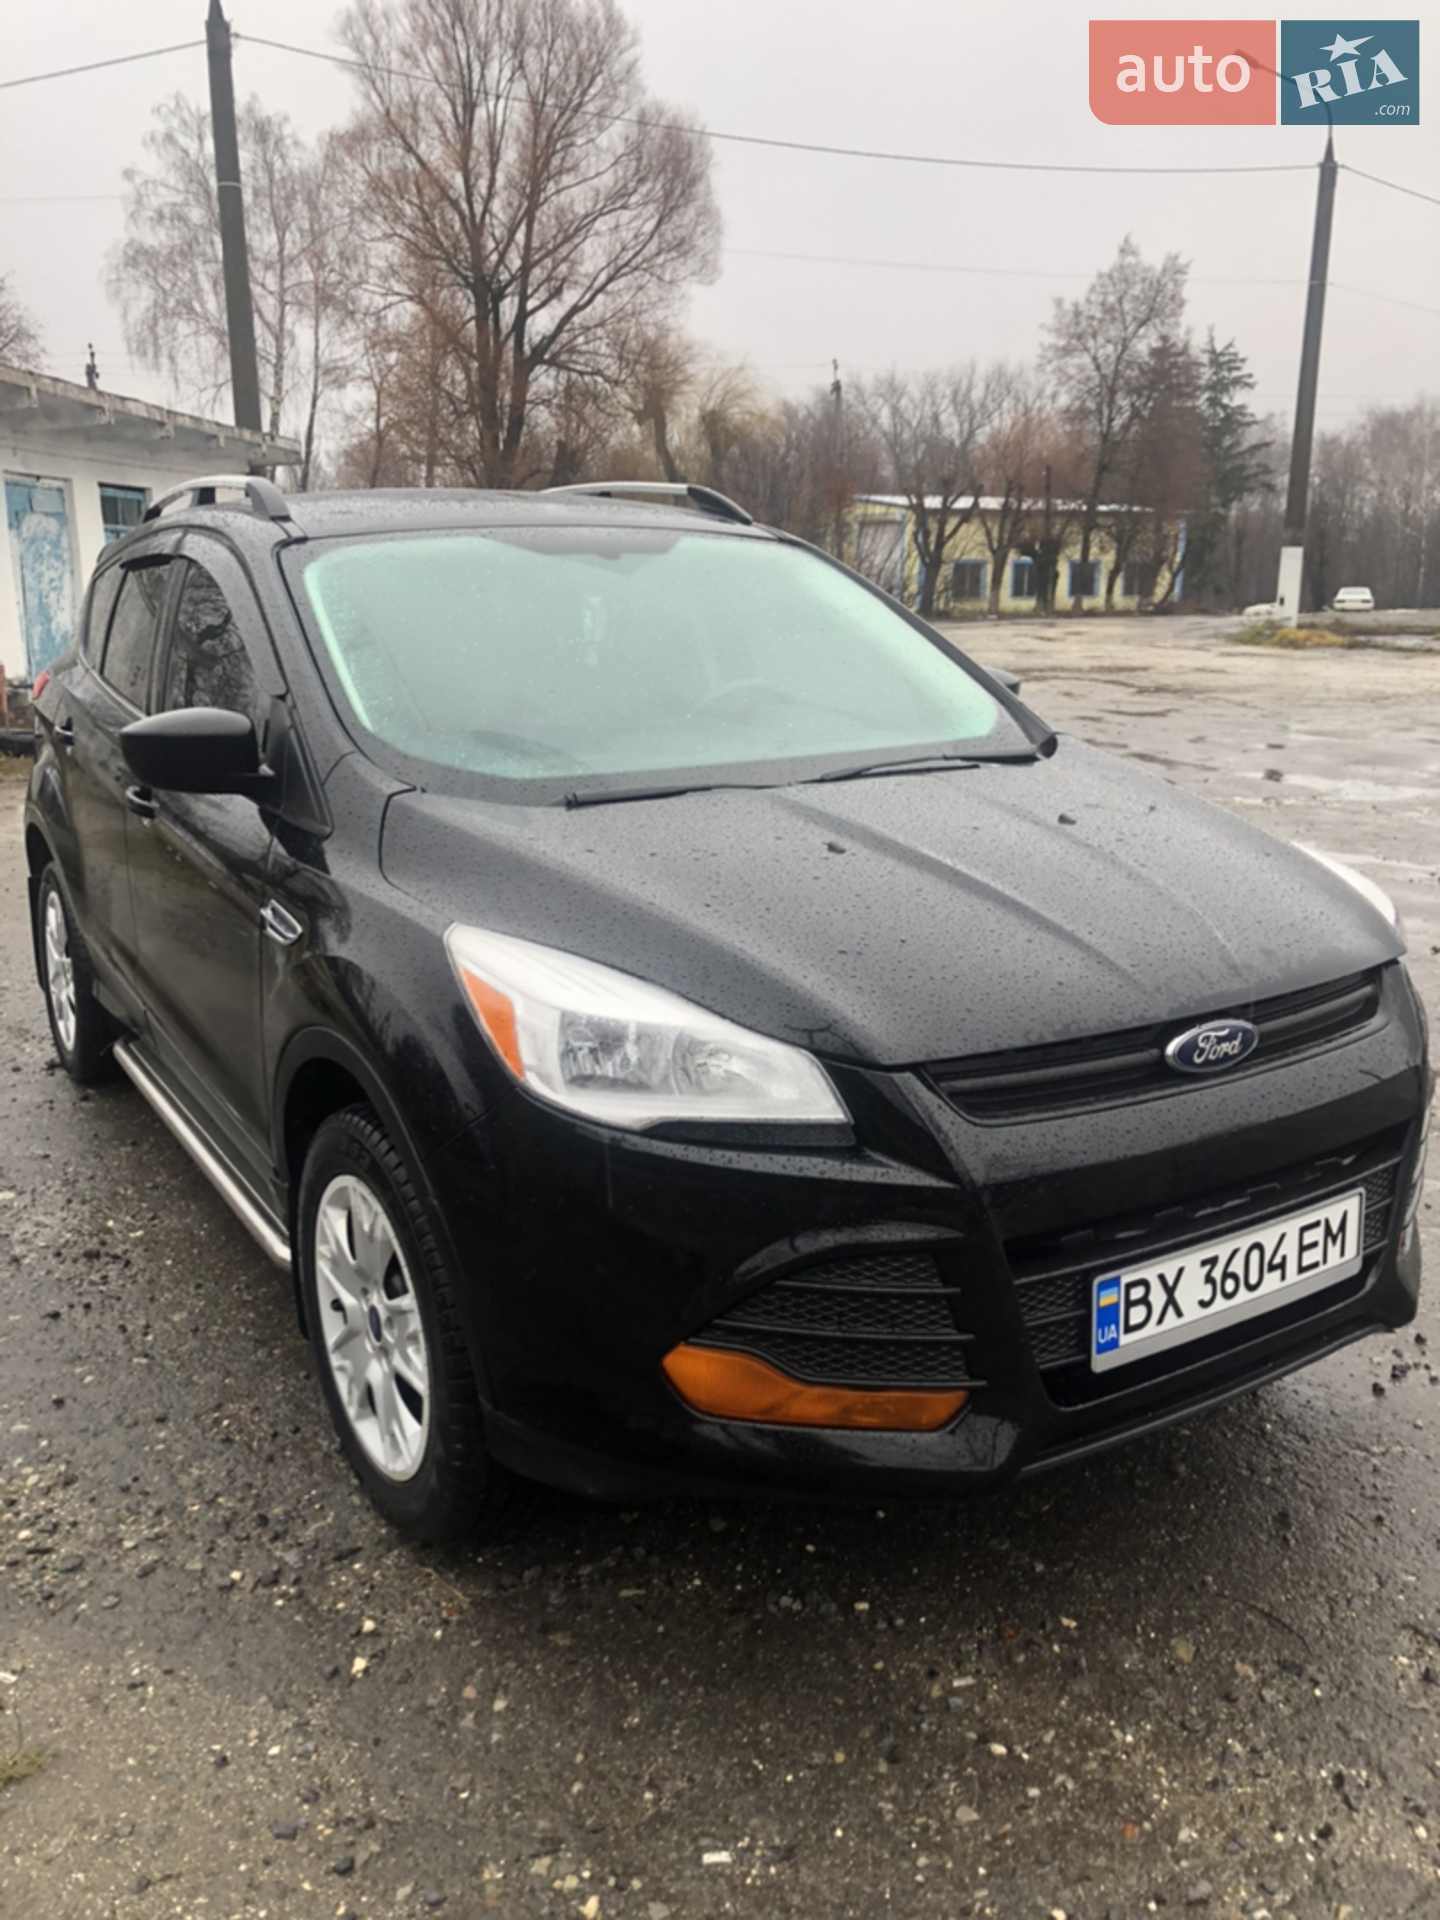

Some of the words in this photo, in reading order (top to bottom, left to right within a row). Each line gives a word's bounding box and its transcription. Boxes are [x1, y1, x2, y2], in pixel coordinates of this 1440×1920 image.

[1193, 1028, 1243, 1064] Ford
[1123, 1265, 1186, 1335] BX
[1198, 1232, 1287, 1309] 3604
[1297, 1209, 1349, 1275] EM
[1098, 1324, 1117, 1343] UA
